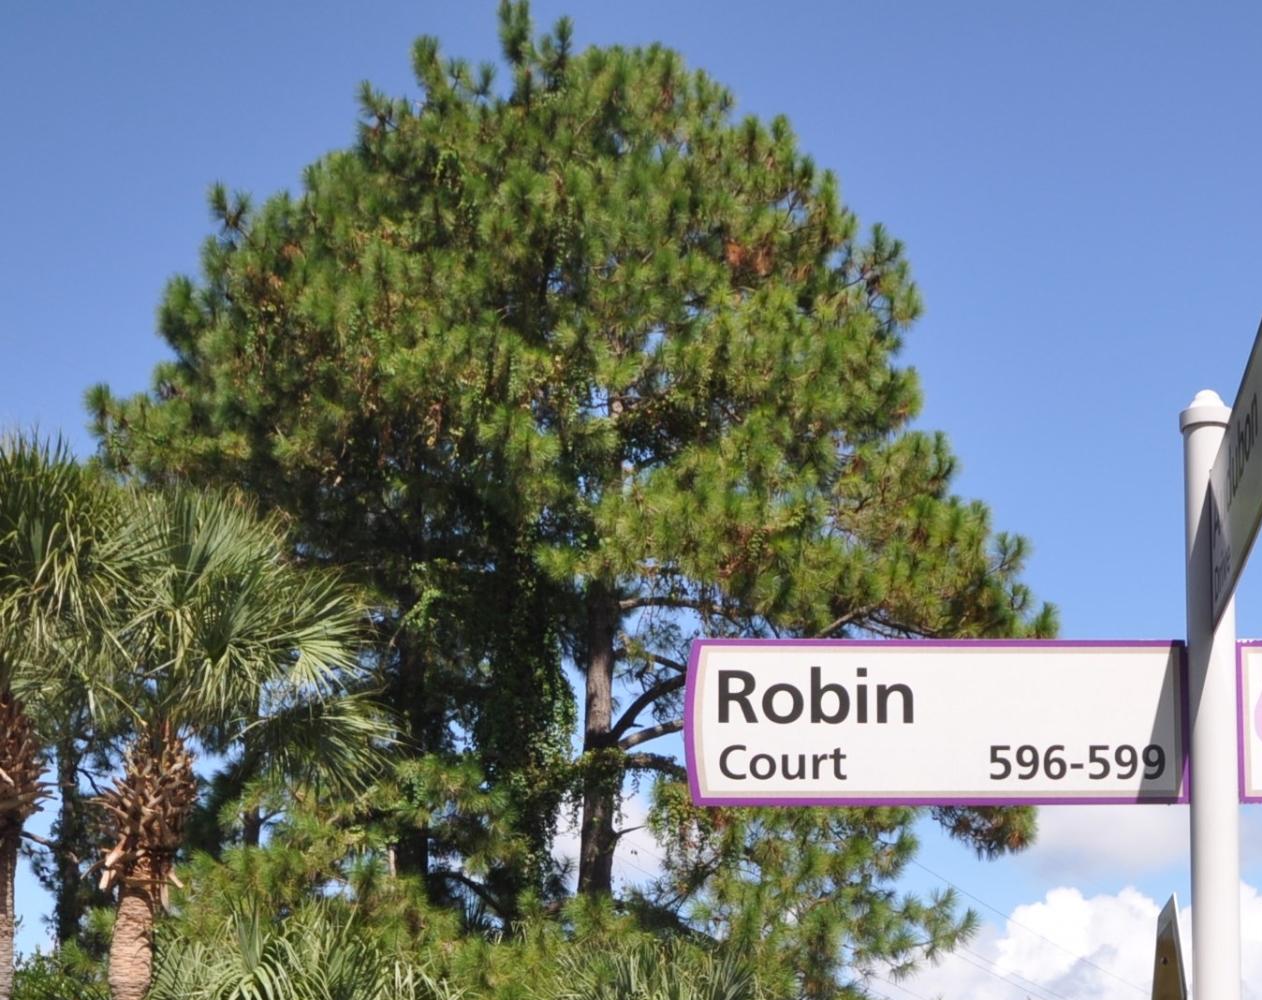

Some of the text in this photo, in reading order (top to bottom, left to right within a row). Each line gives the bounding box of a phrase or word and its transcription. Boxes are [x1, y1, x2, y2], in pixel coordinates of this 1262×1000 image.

[1213, 392, 1259, 547] Adubon
[716, 666, 915, 725] Robin
[718, 744, 1166, 780] Court 596-599
